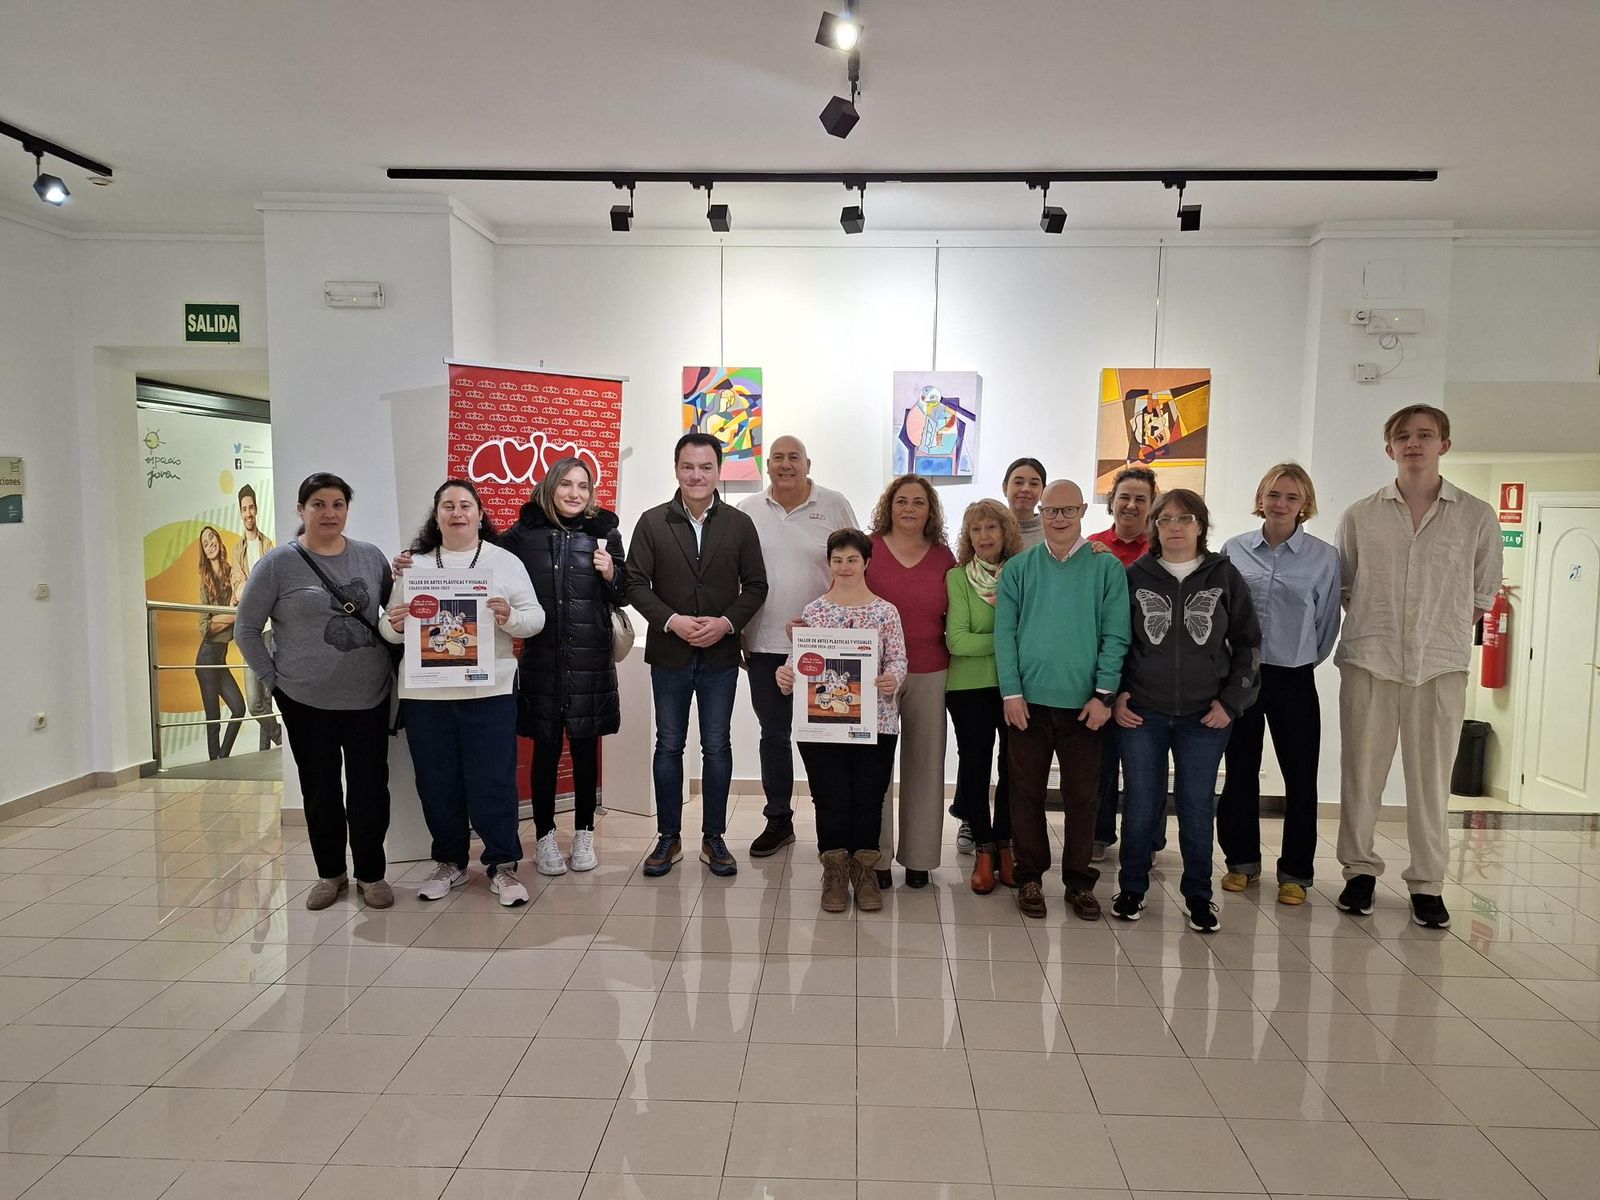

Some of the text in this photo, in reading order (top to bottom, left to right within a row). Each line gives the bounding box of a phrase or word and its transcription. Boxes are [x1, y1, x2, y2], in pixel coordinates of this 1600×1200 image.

[188, 314, 238, 332] SALIDA
[144, 456, 182, 468] espacio
[147, 467, 180, 488] joven
